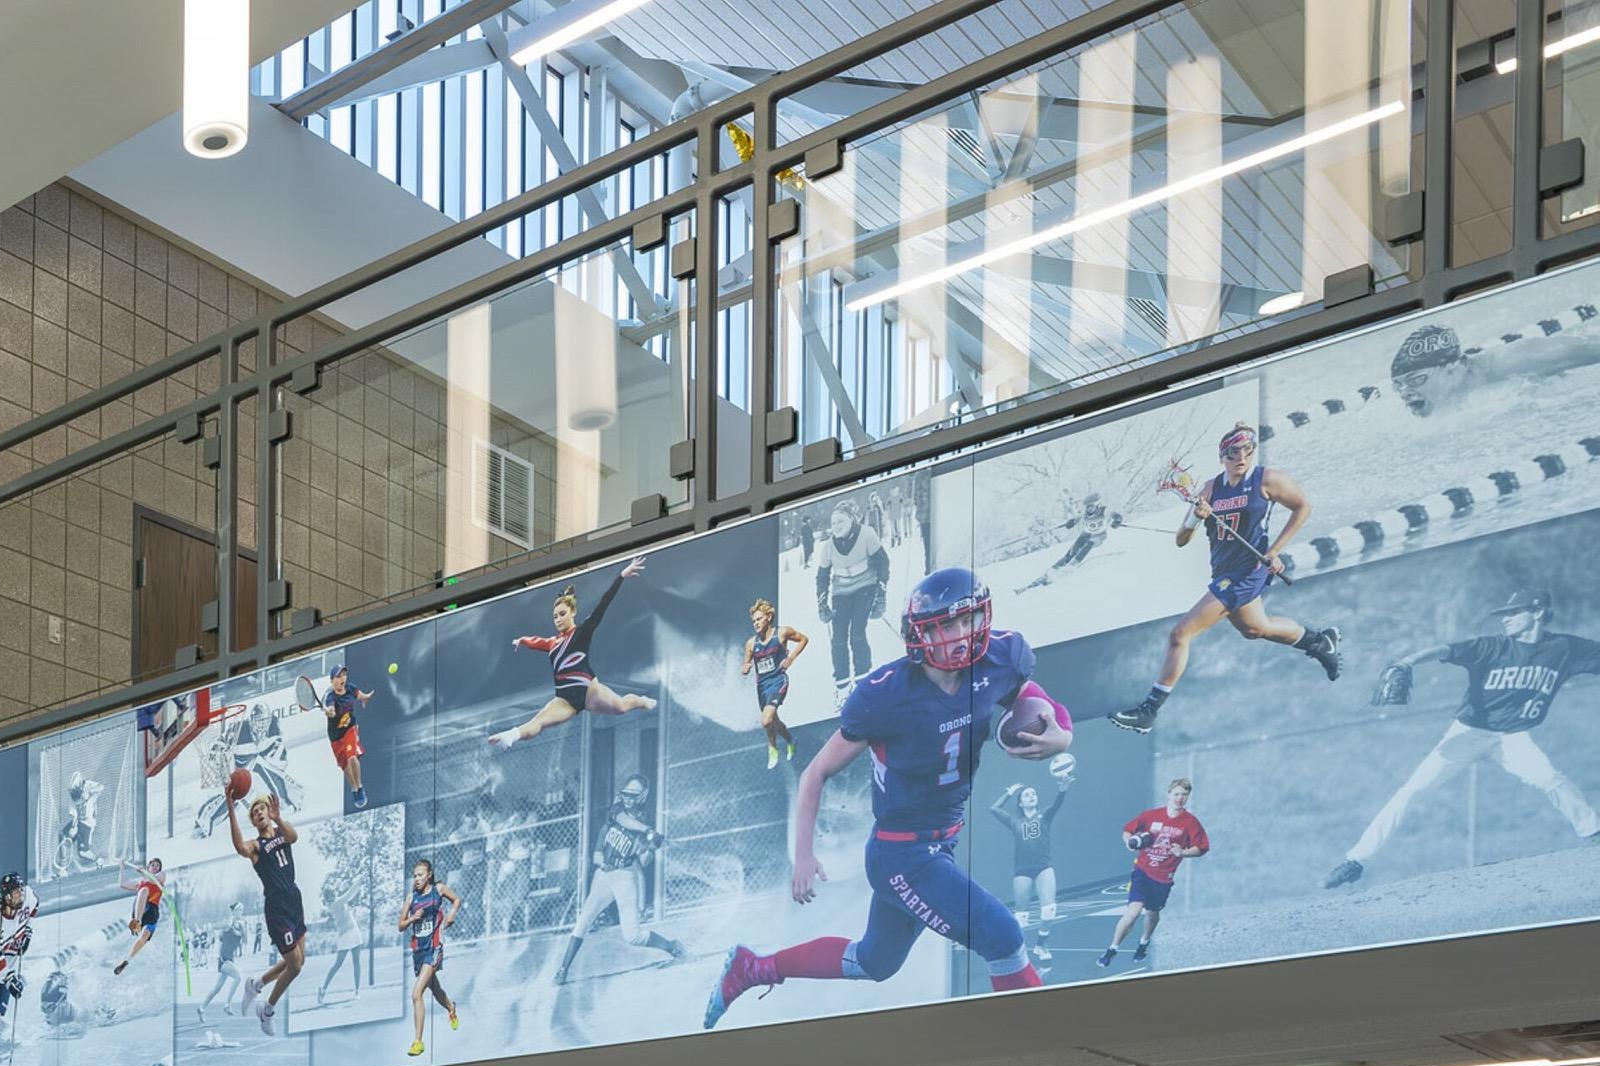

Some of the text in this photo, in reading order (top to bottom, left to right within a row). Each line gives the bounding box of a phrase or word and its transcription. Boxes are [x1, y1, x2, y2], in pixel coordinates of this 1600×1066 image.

[1484, 665, 1559, 695] ORONO
[1519, 699, 1544, 719] 16
[939, 713, 973, 734] ORONO
[938, 731, 962, 786] 1
[1021, 819, 1041, 841] 13
[275, 848, 289, 868] 11
[889, 874, 952, 934] SPARTANS
